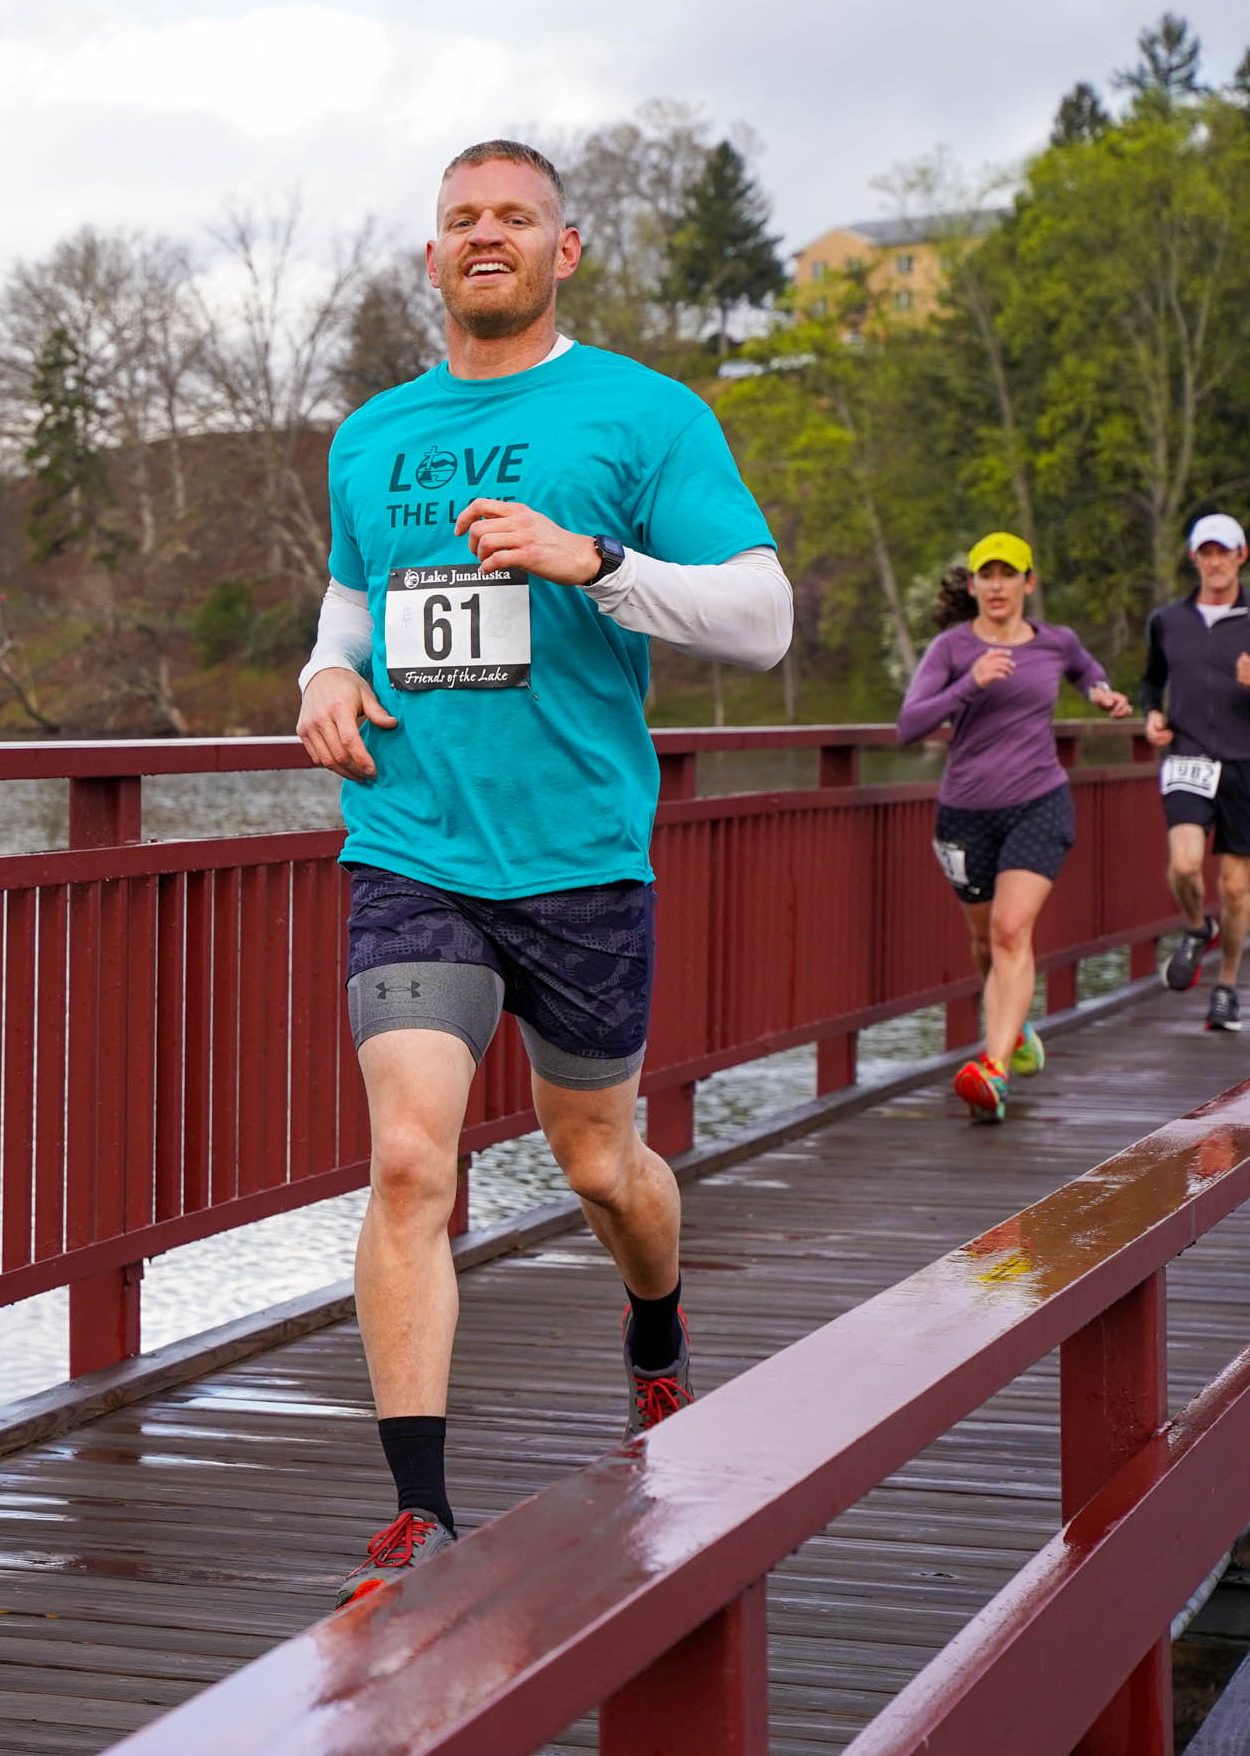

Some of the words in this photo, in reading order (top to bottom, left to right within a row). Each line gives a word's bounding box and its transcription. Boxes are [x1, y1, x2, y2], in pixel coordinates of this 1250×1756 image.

[389, 444, 530, 492] LOVE
[386, 502, 439, 528] THE
[420, 570, 448, 584] Lake
[450, 569, 511, 585] Junaluska
[423, 593, 481, 661] 61
[405, 669, 445, 684] Friends
[447, 669, 460, 688] of
[459, 669, 477, 682] the
[478, 667, 510, 682] Lake
